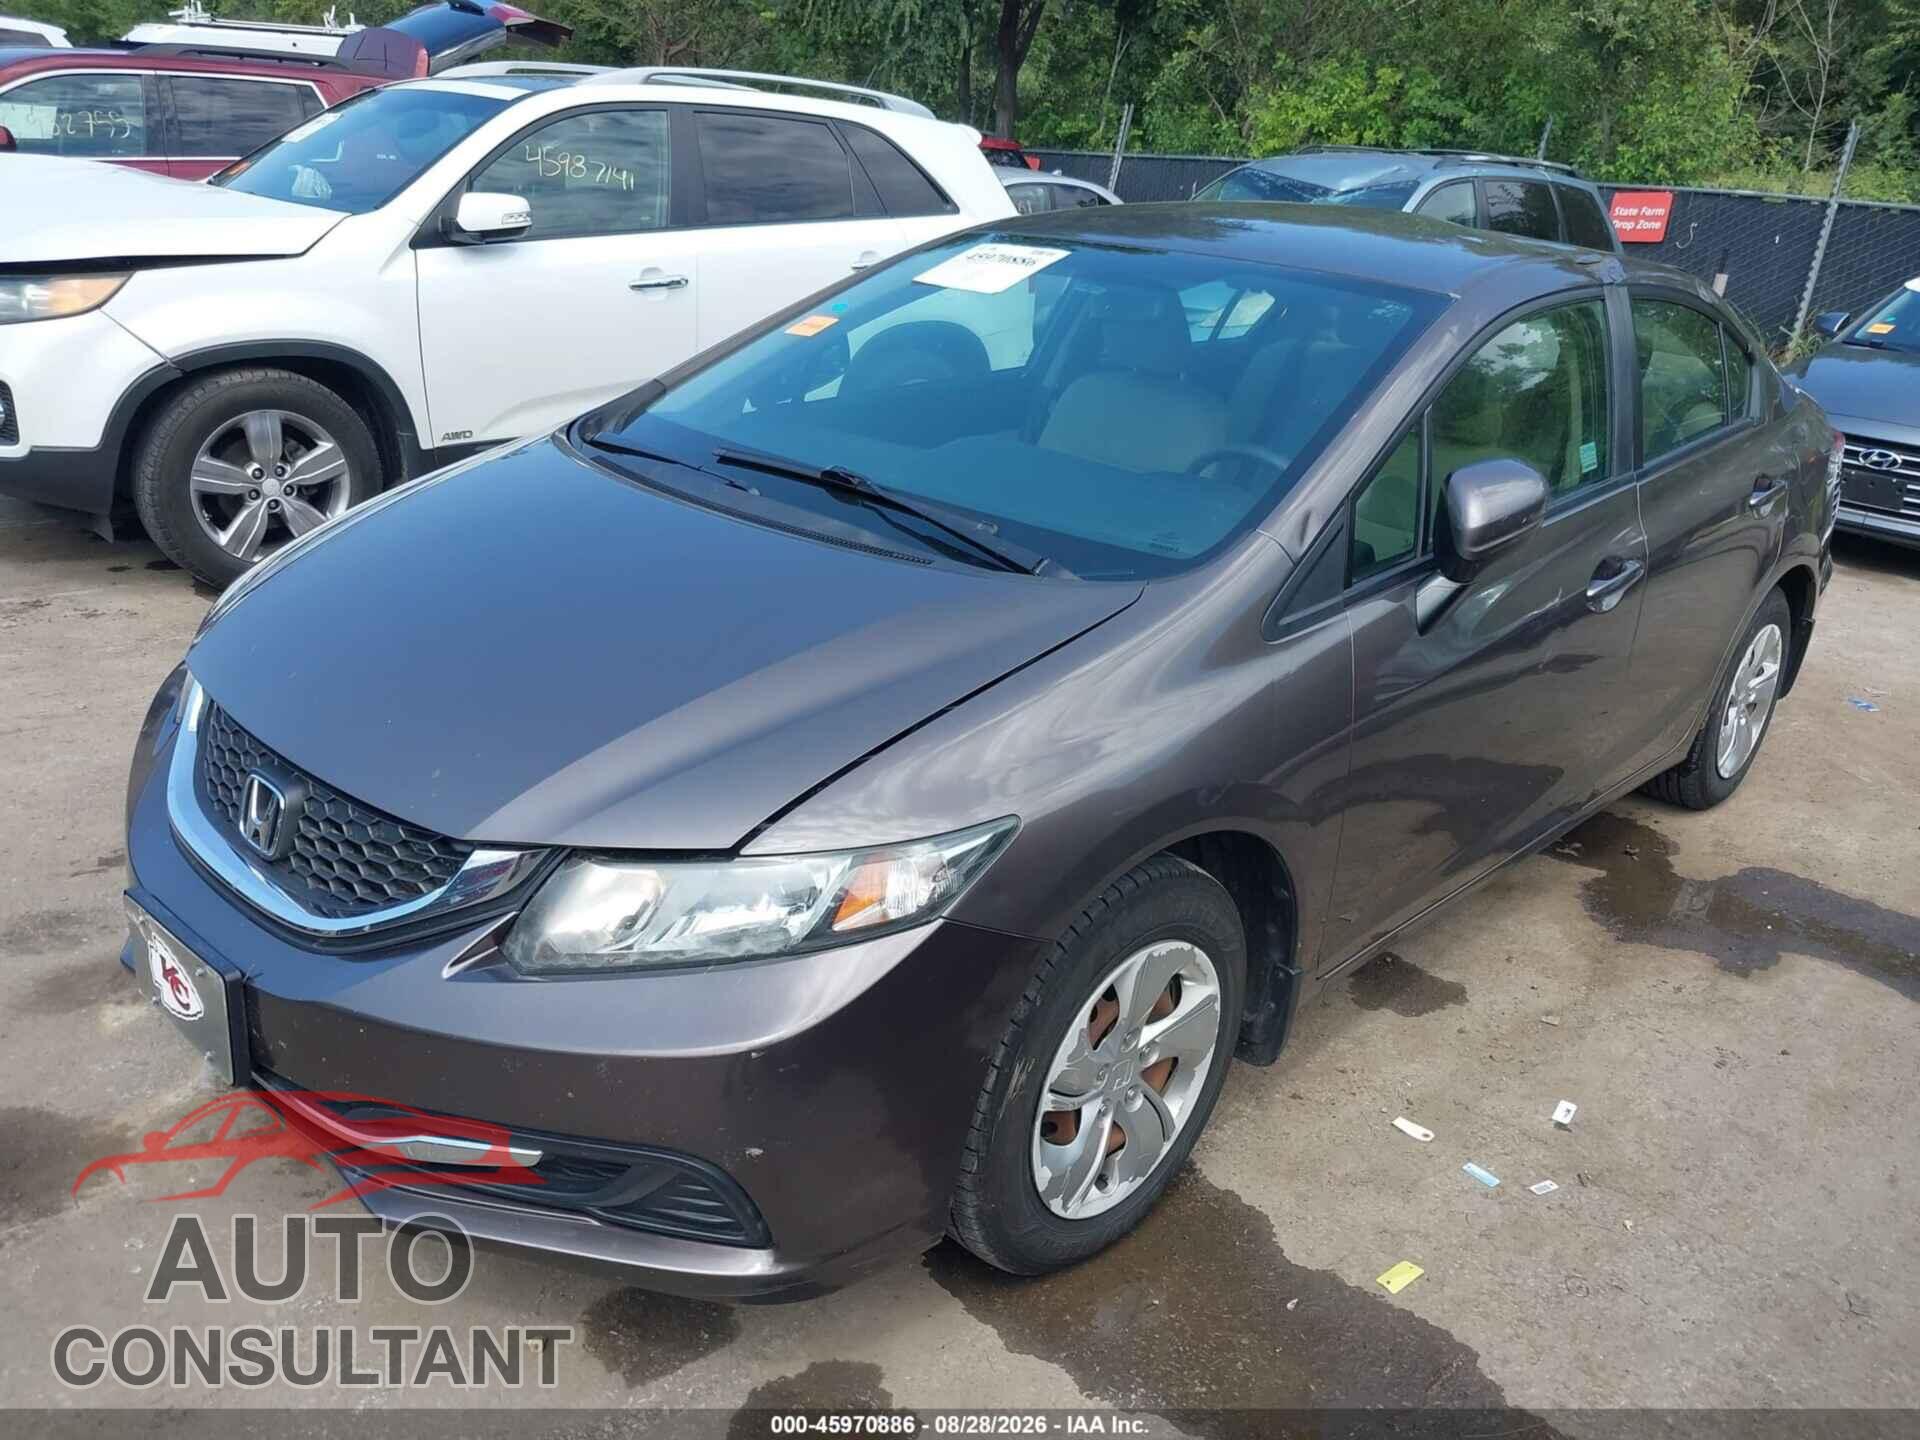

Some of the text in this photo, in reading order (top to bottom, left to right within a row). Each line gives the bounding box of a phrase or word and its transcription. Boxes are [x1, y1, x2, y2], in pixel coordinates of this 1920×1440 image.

[1613, 206, 1665, 217] State Farm
[1636, 220, 1662, 231] Zone
[441, 430, 473, 441] AWD
